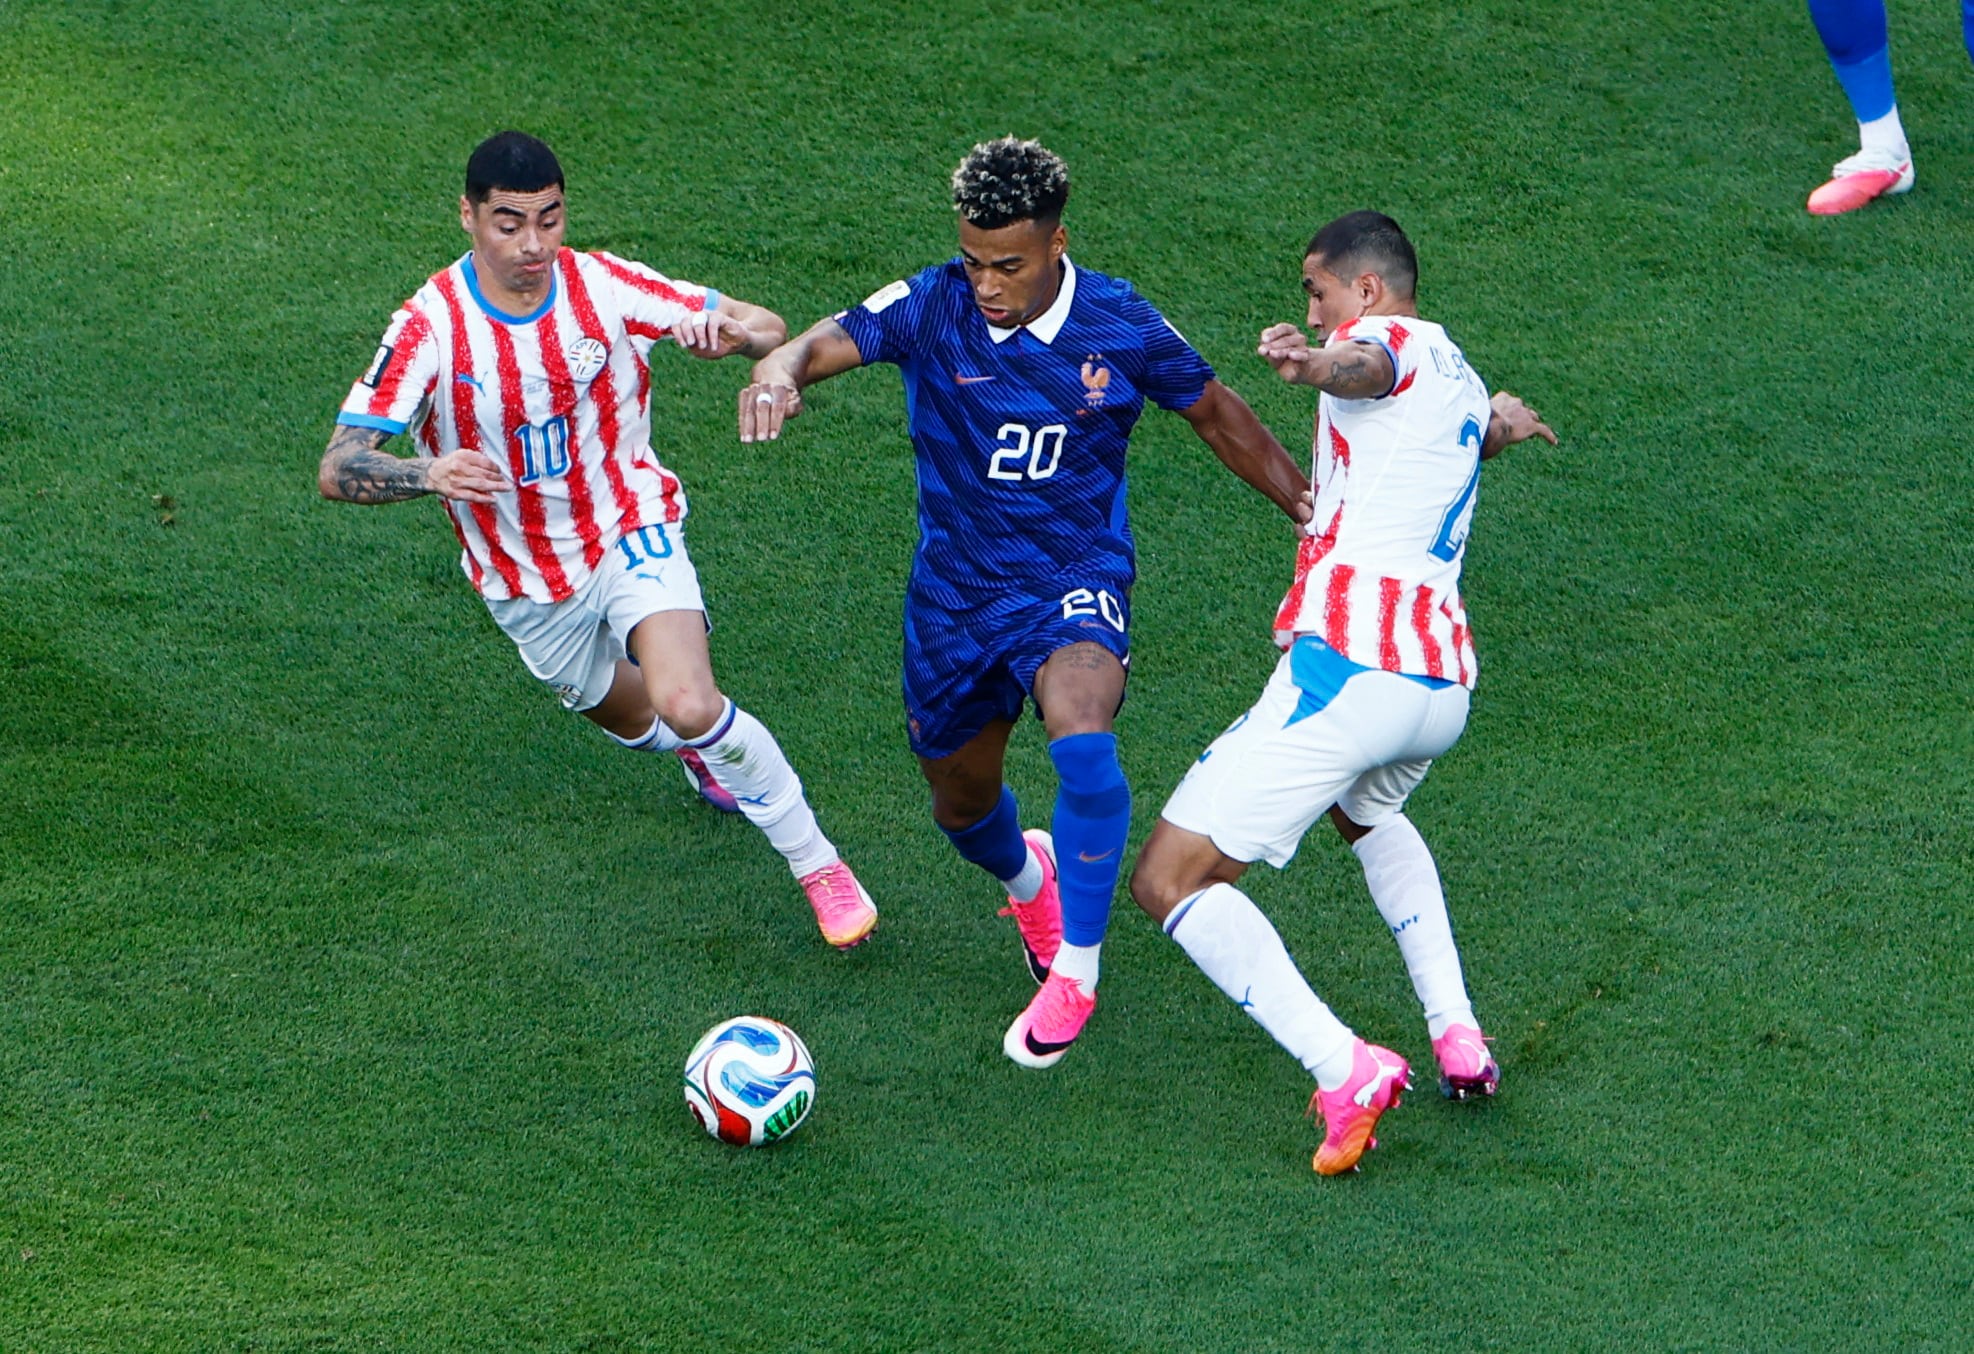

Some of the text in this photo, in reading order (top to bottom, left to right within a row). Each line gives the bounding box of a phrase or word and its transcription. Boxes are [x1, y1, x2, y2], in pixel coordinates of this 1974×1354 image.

[514, 415, 572, 487] 10
[987, 423, 1068, 481] 20
[1428, 413, 1482, 564] 2
[615, 524, 673, 571] 10
[1060, 588, 1125, 633] 20
